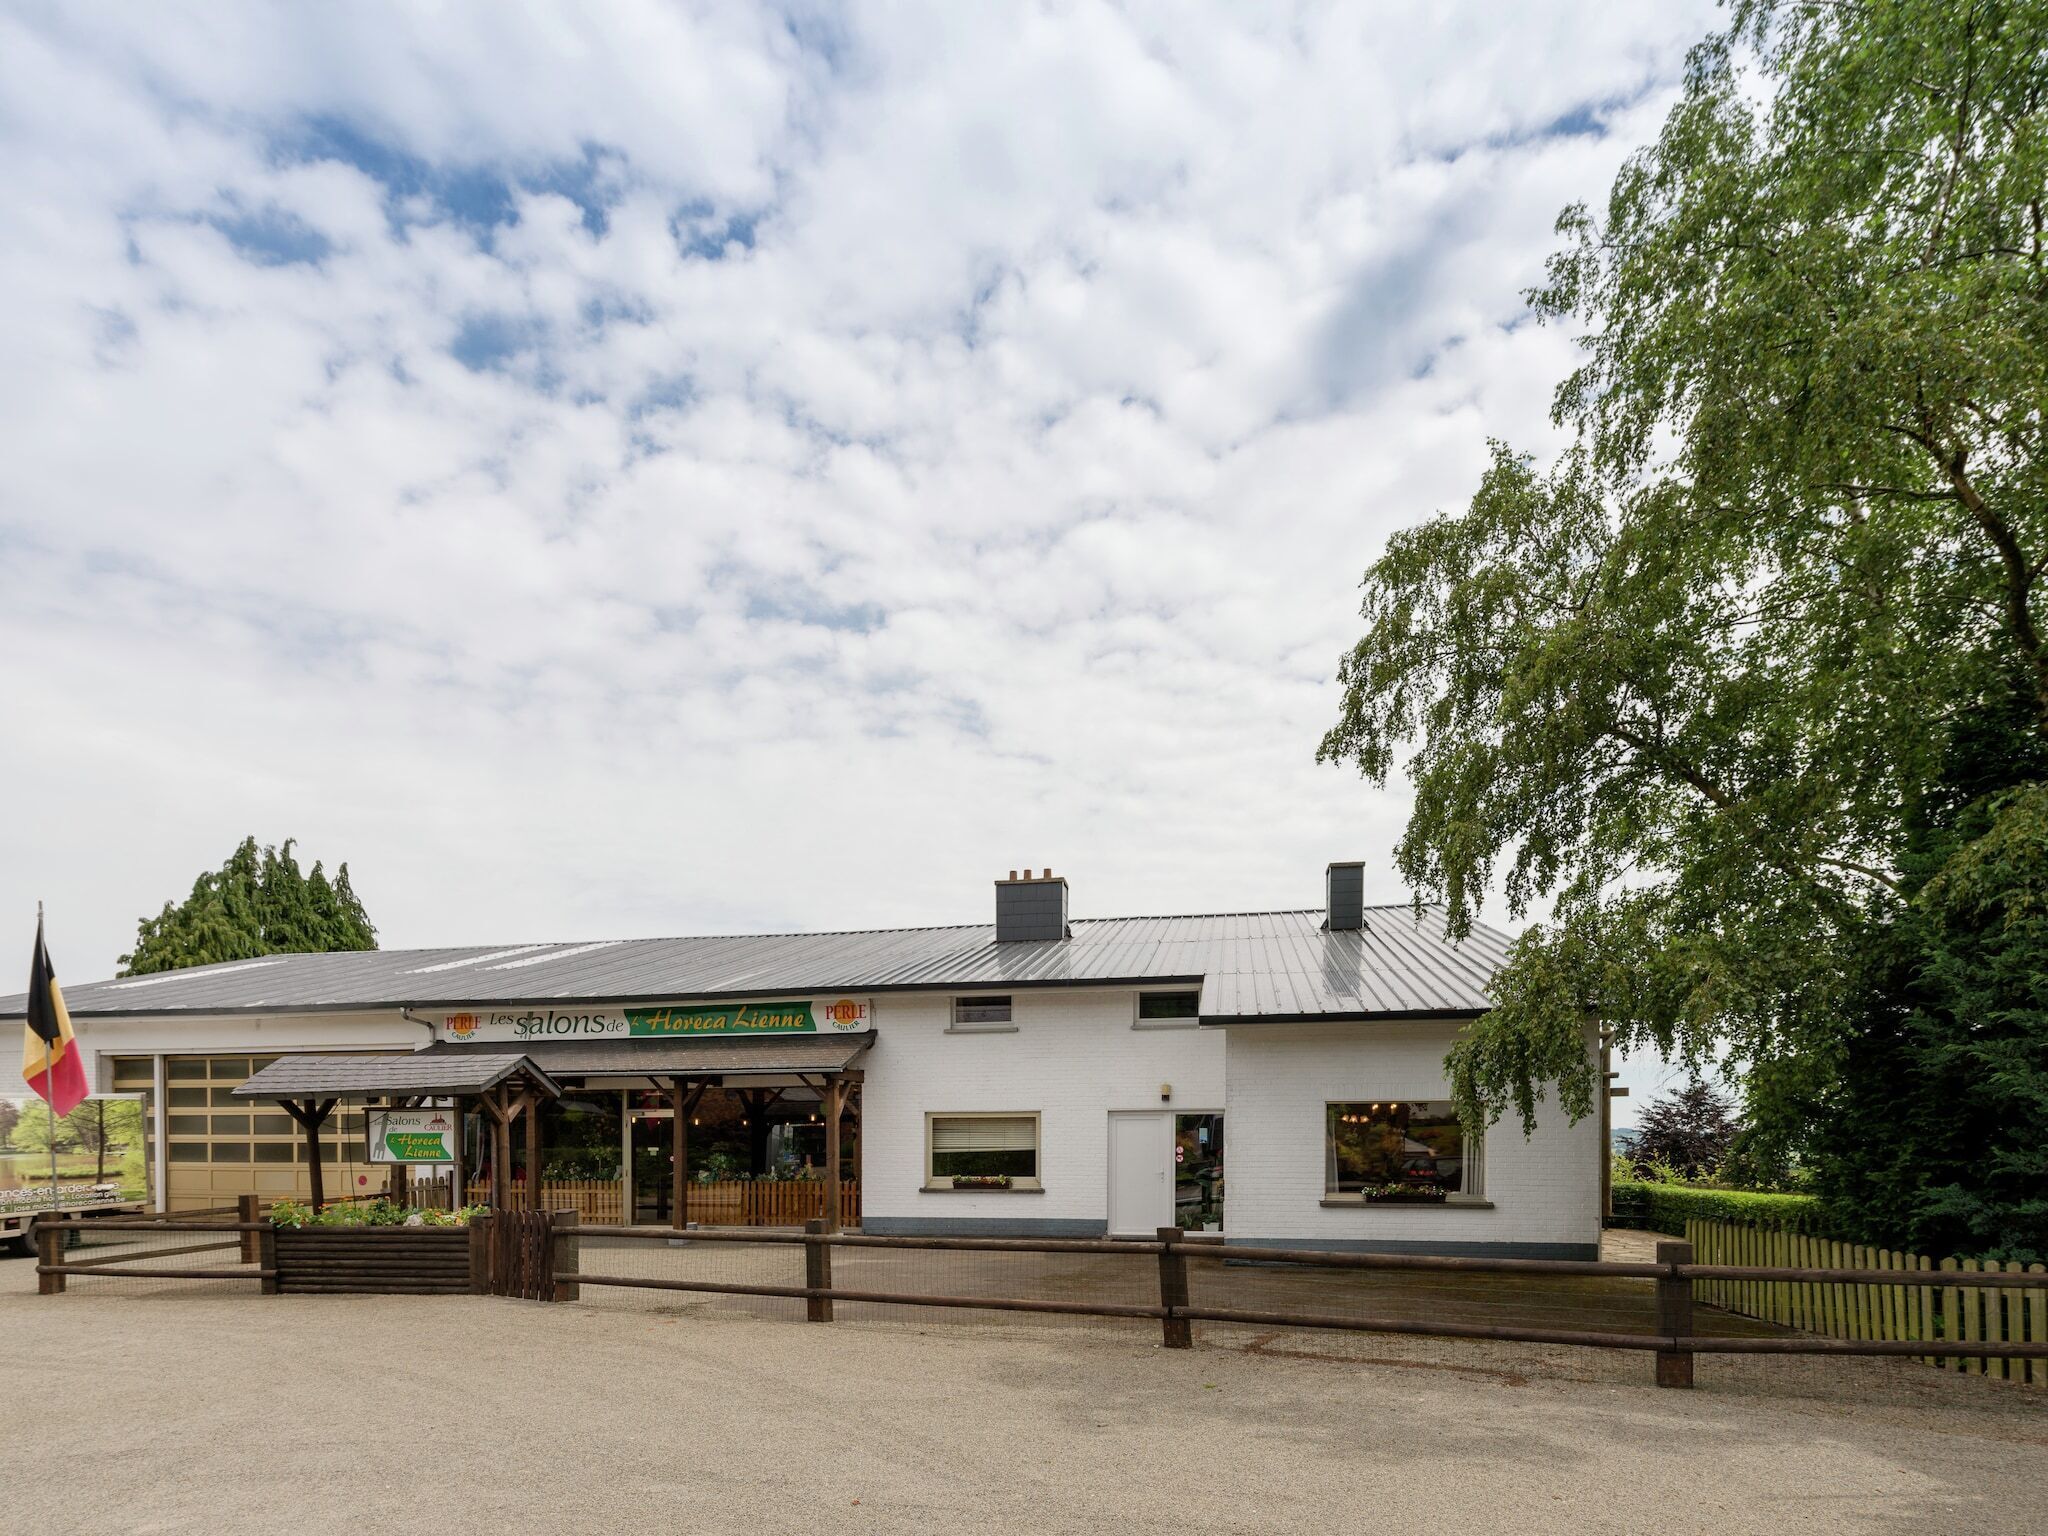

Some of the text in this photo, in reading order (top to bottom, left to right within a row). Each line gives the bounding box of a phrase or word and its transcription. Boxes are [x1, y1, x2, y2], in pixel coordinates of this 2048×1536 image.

[825, 1004, 867, 1020] PERLE
[446, 1015, 482, 1030] PERLE
[489, 1013, 514, 1025] Les
[514, 1010, 605, 1034] salons
[606, 1019, 623, 1032] de
[646, 1008, 726, 1032] Horeca
[732, 1005, 805, 1029] Lienne
[832, 1019, 860, 1031] CAULIER
[451, 1030, 475, 1040] CAULIER
[424, 1123, 453, 1131] CAULIER
[397, 1134, 441, 1146] Horeca
[404, 1145, 442, 1158] Lienne
